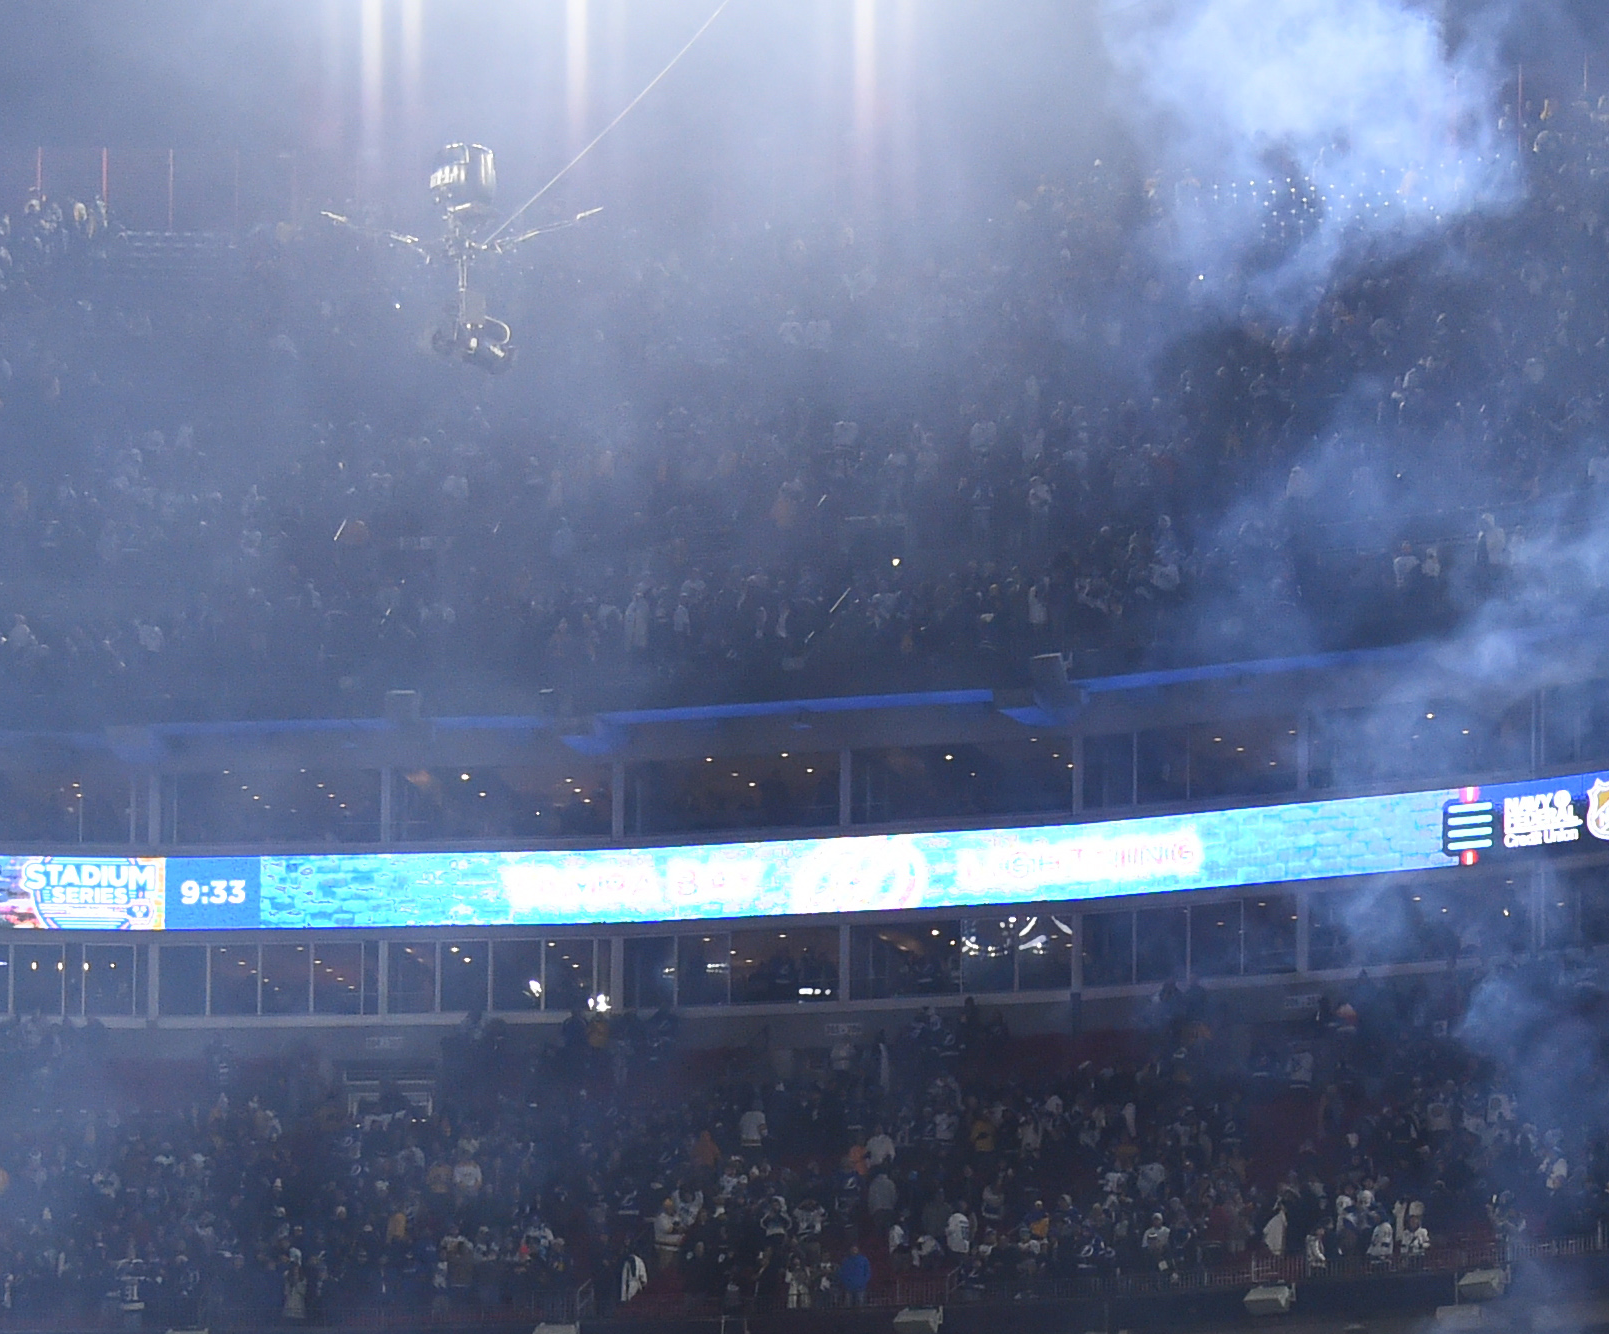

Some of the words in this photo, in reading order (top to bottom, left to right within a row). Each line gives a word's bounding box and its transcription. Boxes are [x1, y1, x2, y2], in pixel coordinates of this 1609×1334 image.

[23, 856, 157, 890] STADIUM
[50, 886, 129, 904] SERIES
[180, 879, 246, 904] 9:33
